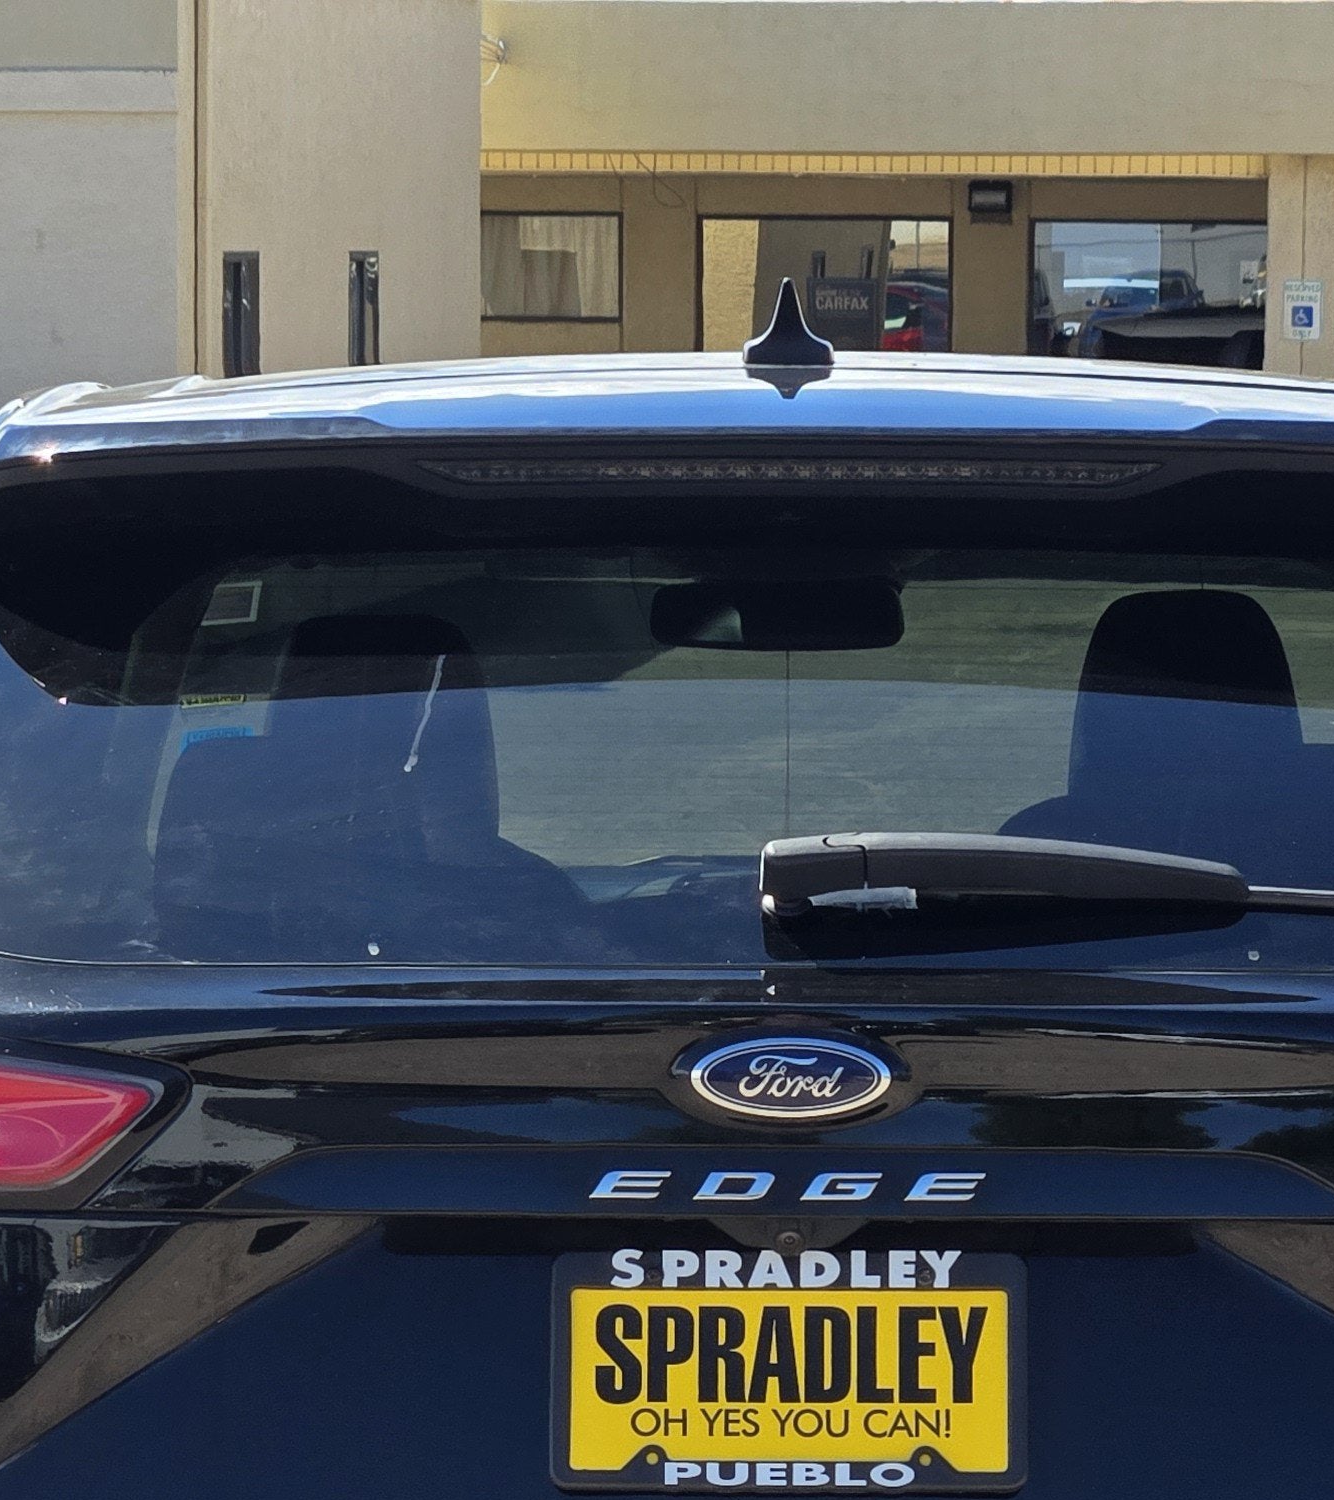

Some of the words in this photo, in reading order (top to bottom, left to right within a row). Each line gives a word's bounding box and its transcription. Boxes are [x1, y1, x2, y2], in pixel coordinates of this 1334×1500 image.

[815, 295, 870, 311] CARFAX
[1286, 294, 1318, 303] PARKING
[738, 1054, 843, 1099] Ford
[588, 1170, 987, 1202] EDGE
[594, 1303, 988, 1405] SPRADLEY
[630, 1408, 688, 1438] OH
[700, 1408, 760, 1438] YES
[771, 1408, 850, 1439] YOU
[862, 1408, 953, 1439] CAN!
[663, 1460, 916, 1488] PUEBLO
